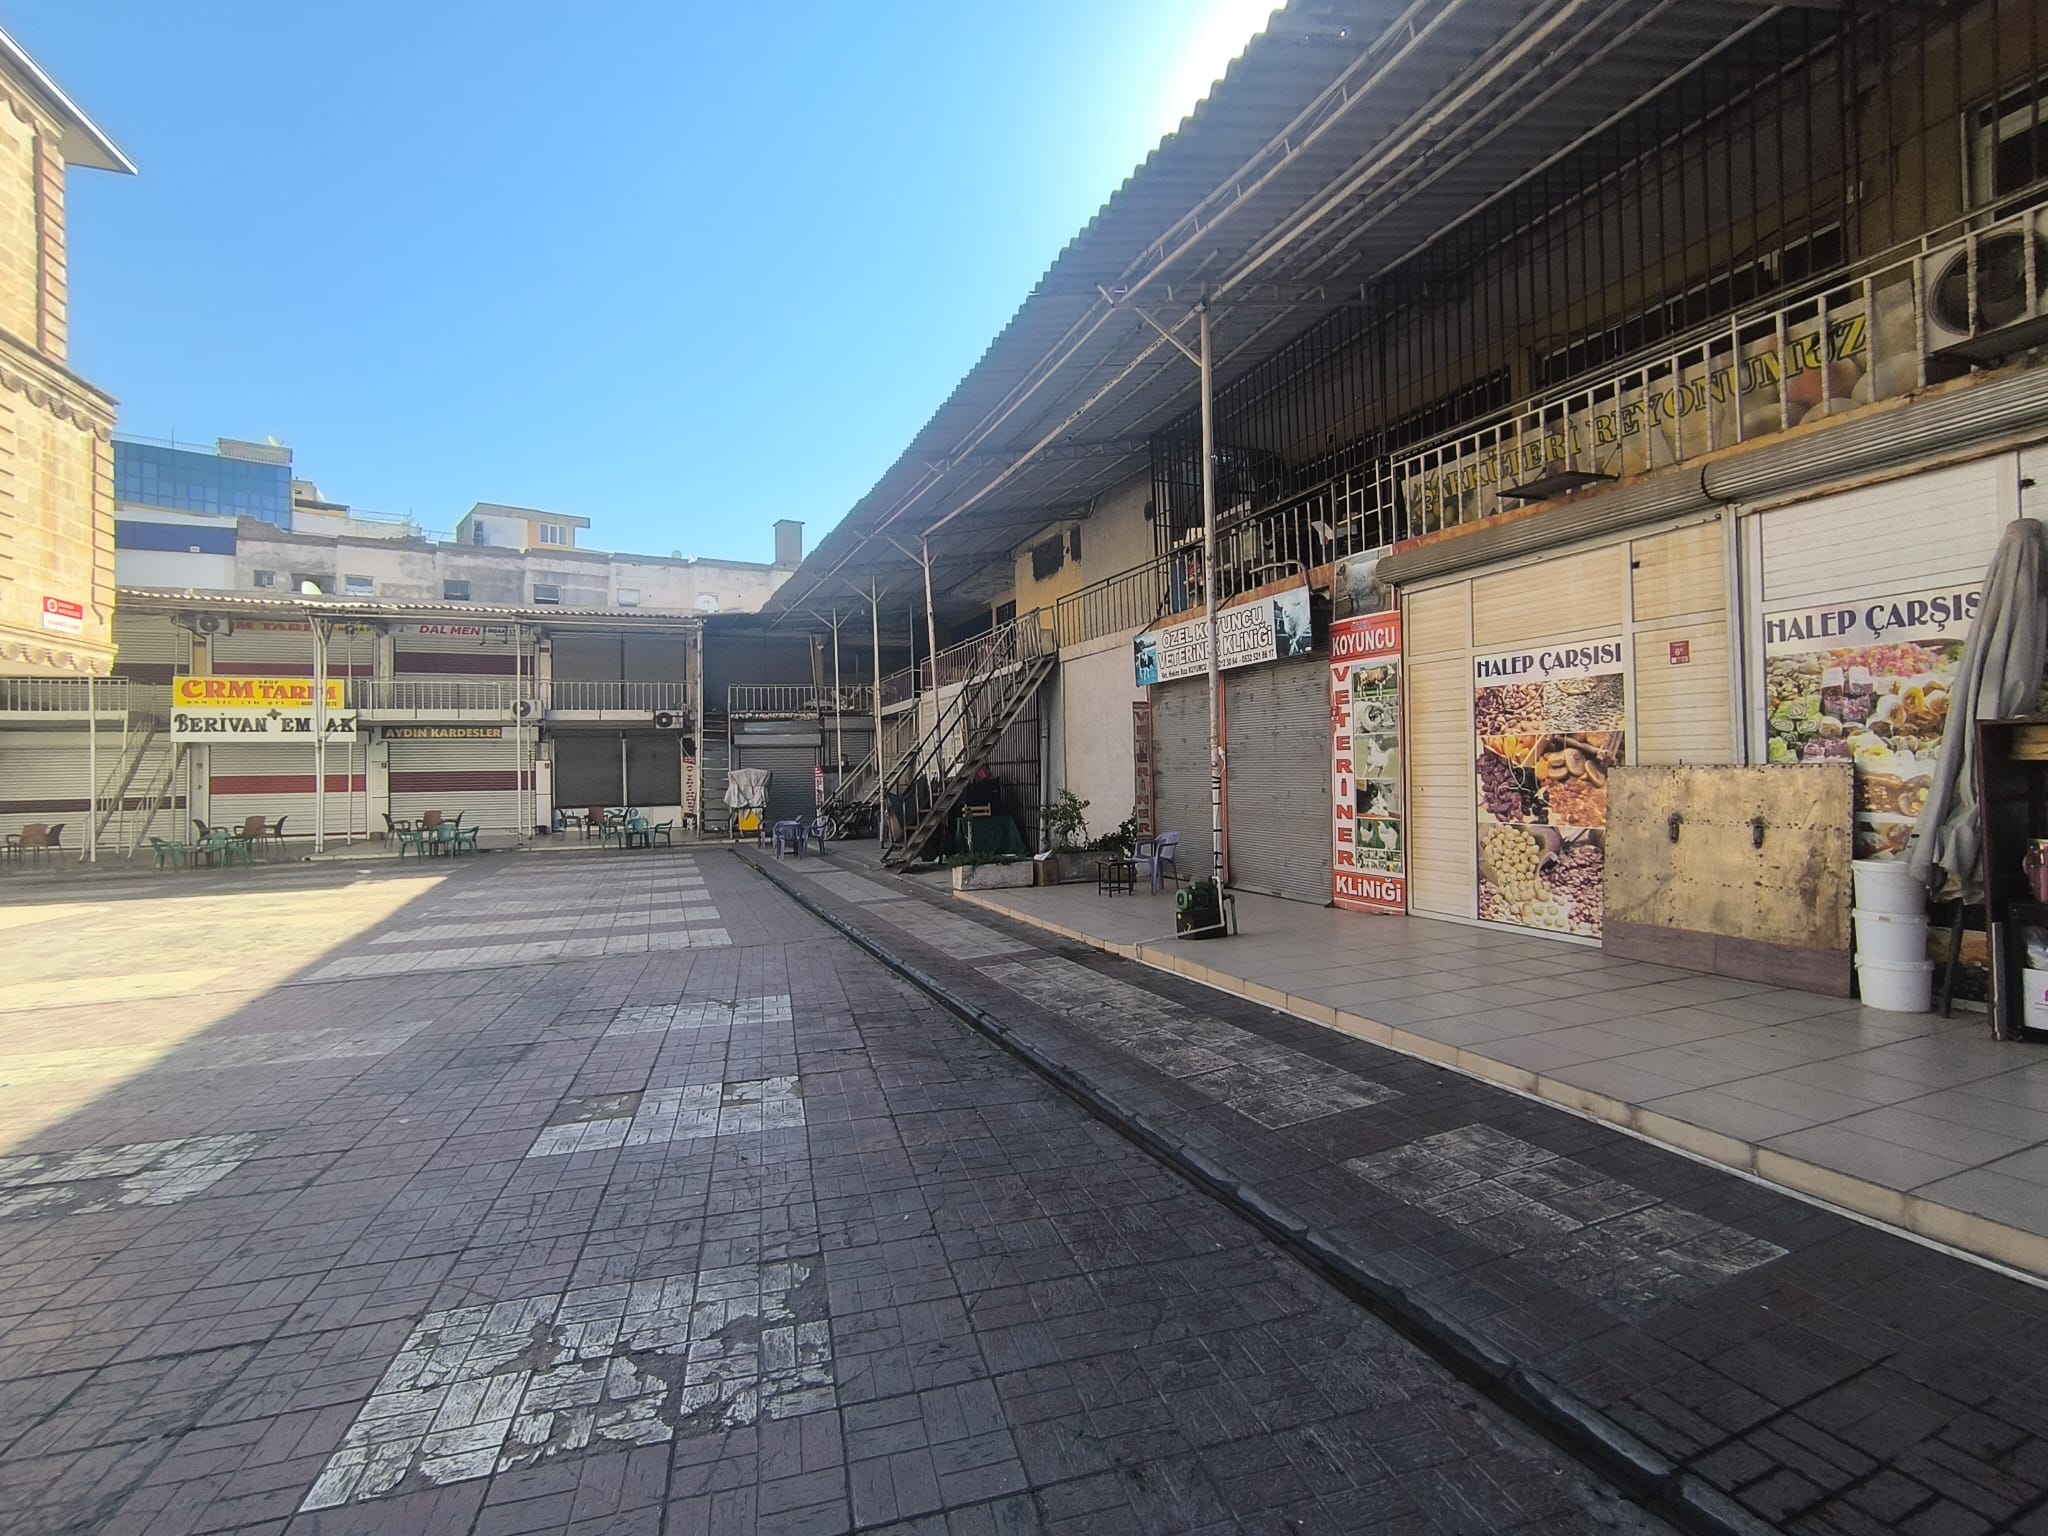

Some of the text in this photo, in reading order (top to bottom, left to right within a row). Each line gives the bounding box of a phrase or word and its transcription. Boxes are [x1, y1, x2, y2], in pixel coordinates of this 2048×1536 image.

[1586, 313, 1867, 447] REYONUMUZ
[1765, 592, 1981, 644] HALEP ÇARŞIS
[419, 625, 481, 635] DAL MEN
[1162, 628, 1193, 649] ÖZEL
[1332, 626, 1396, 656] KOYUNCU
[1476, 643, 1621, 679] HALEP ÇARŞISI
[181, 679, 256, 699] CRM
[174, 713, 356, 733] BERİVAN EMAK
[386, 728, 427, 738] AYDIN
